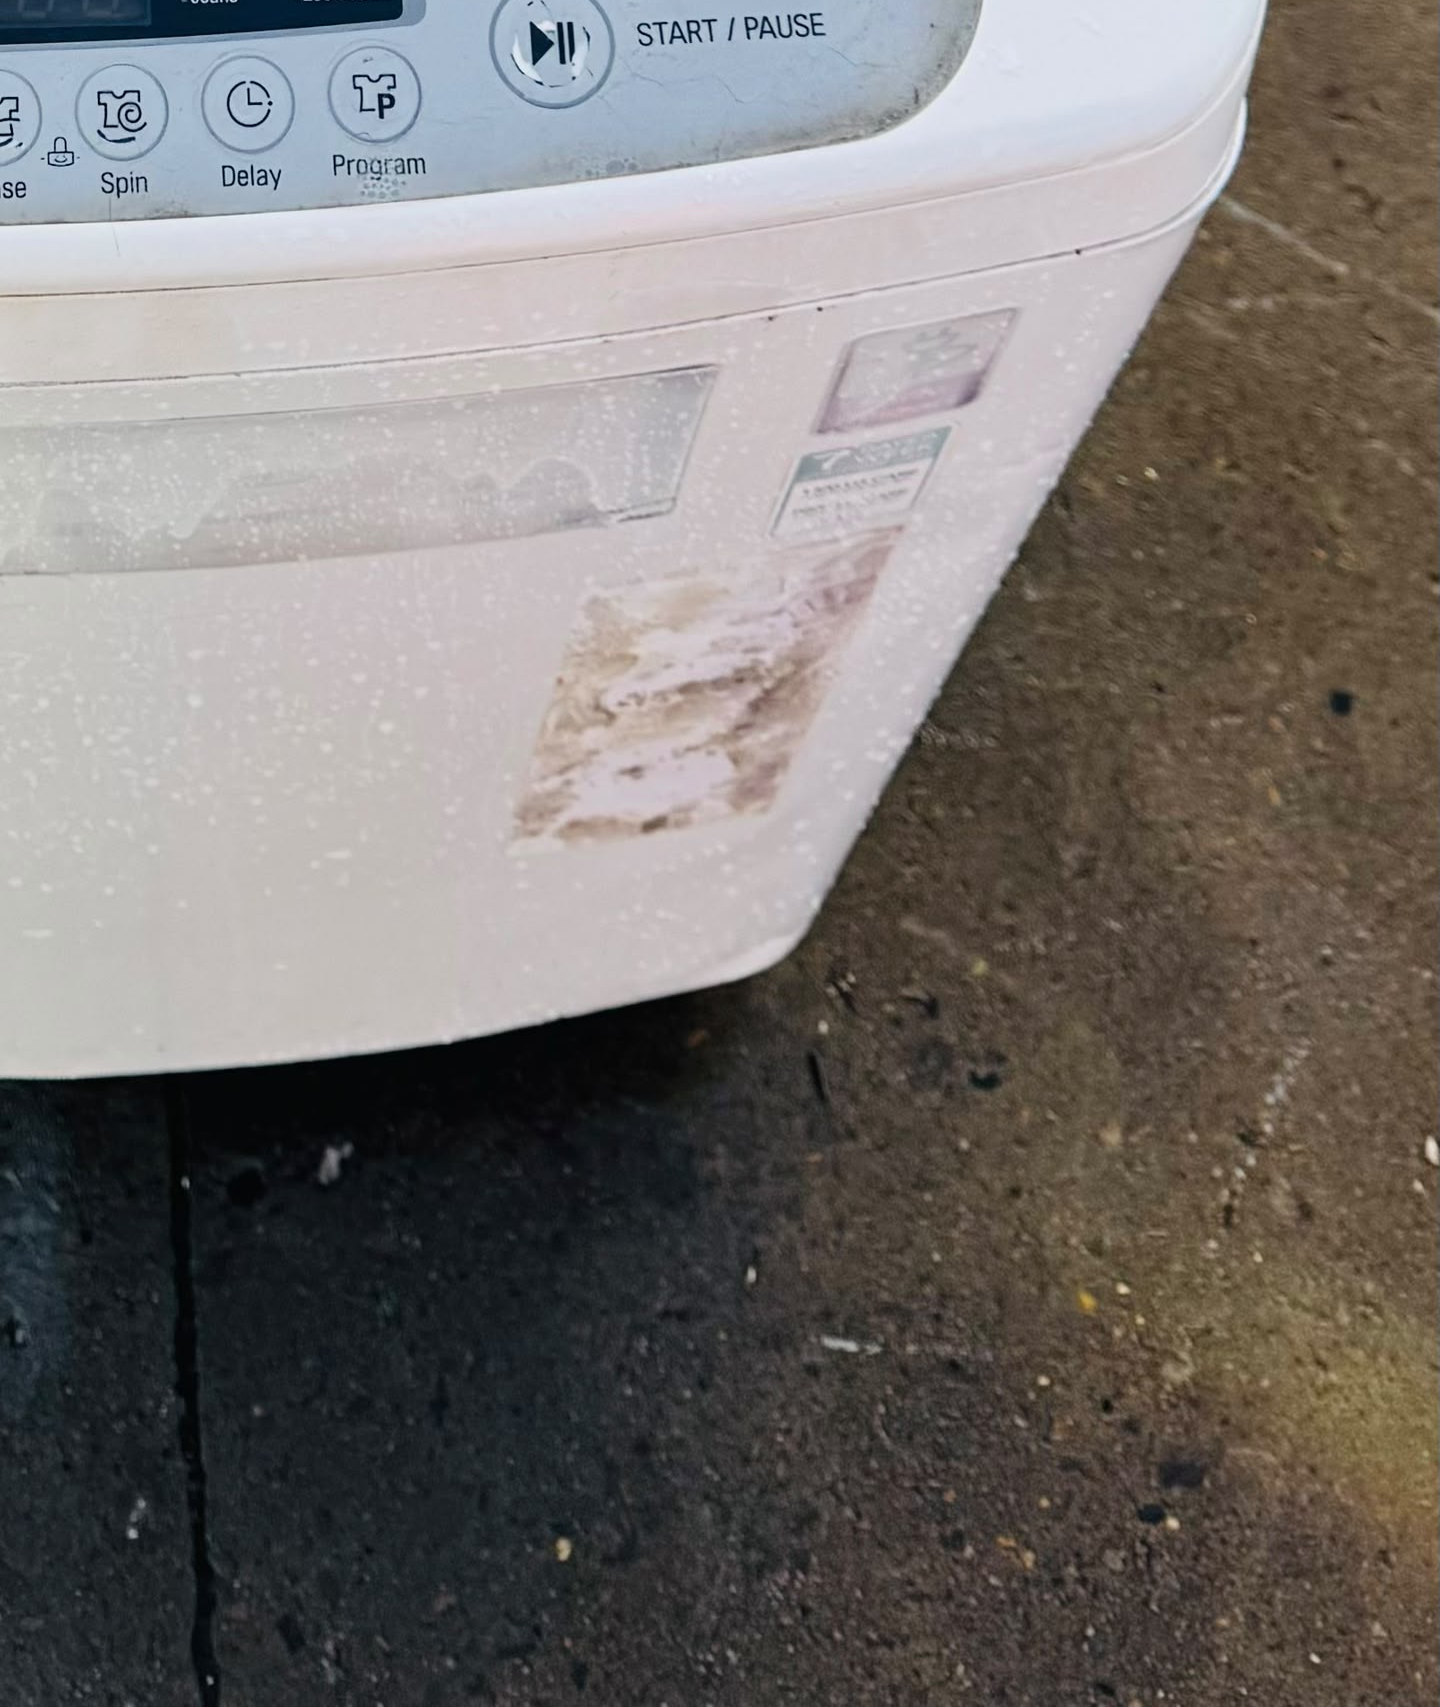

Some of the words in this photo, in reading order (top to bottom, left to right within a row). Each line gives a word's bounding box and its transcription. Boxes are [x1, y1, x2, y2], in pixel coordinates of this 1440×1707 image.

[636, 18, 718, 47] START
[743, 12, 827, 41] PAUSE
[221, 163, 283, 191] Delay
[332, 152, 427, 181] Program
[100, 170, 149, 196] Spin
